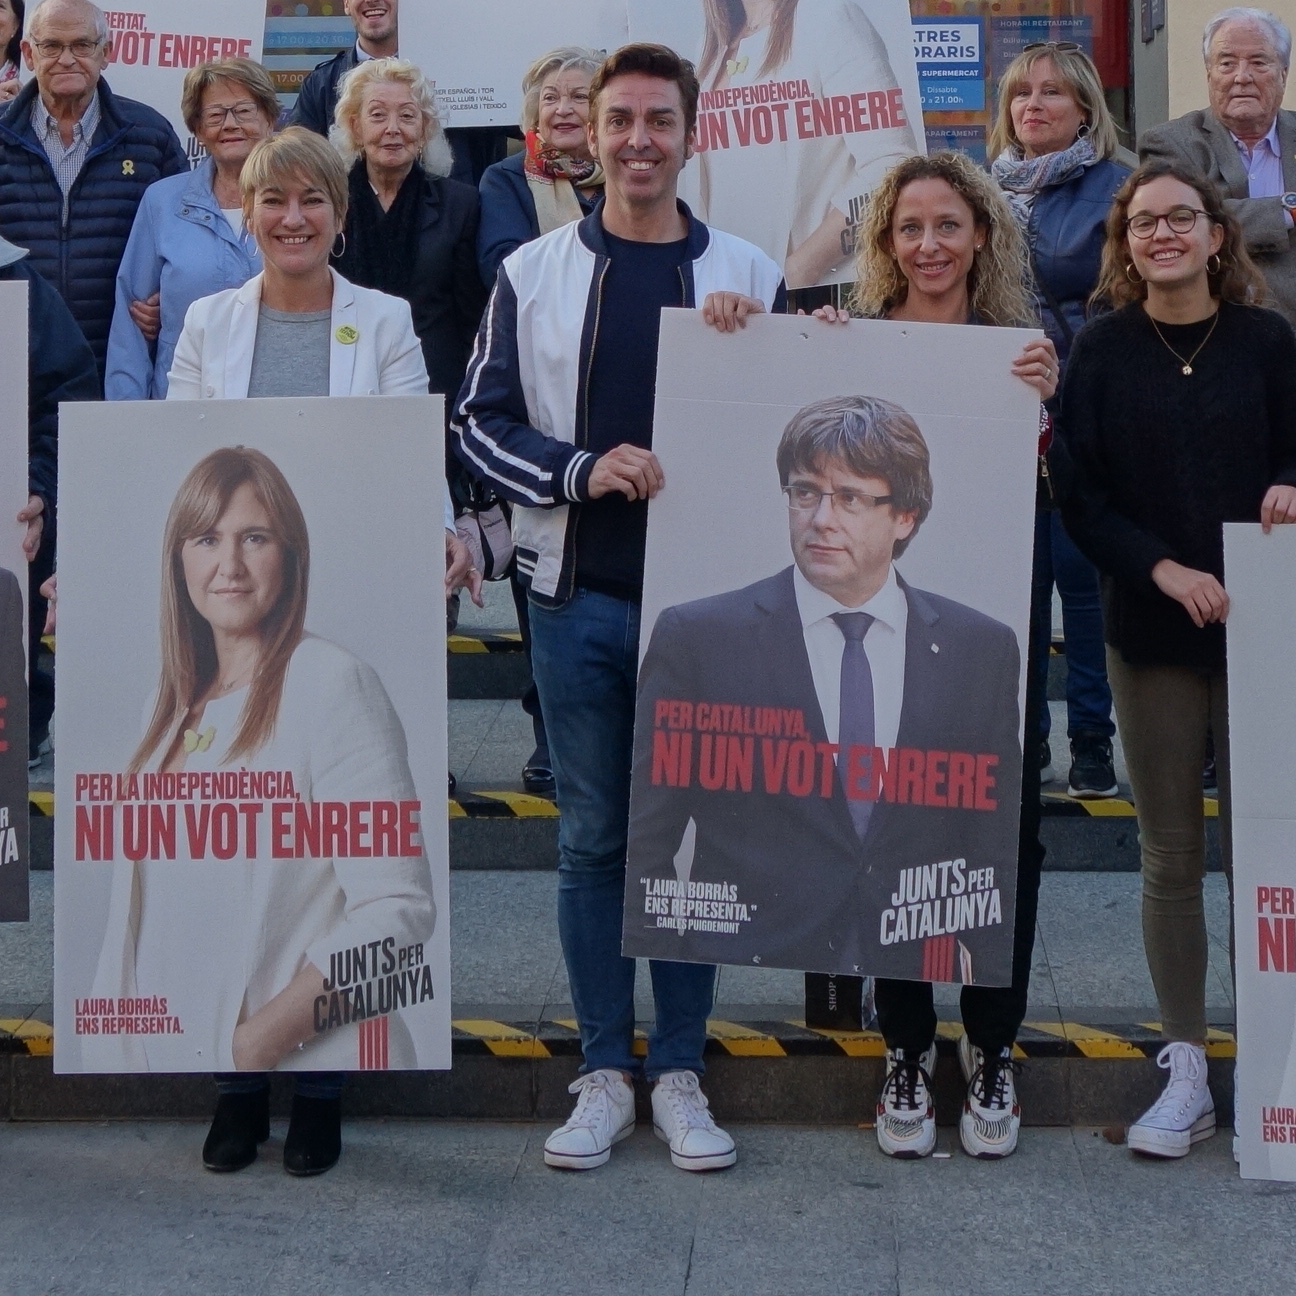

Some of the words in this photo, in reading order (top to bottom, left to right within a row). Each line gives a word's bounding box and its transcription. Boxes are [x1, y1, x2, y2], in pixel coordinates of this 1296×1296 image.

[104, 11, 147, 32] BERTAT,
[1032, 19, 1084, 27] RESTAURANT
[913, 30, 961, 43] TRES
[448, 87, 477, 95] ESPAÑOL
[700, 79, 815, 110] INDEPENDÈNCIA,
[934, 96, 964, 104] 21.00h
[731, 103, 789, 147] VOT
[796, 88, 907, 140] ENRERE
[655, 700, 692, 731] PER
[697, 702, 812, 742] CATALUNYA,
[76, 773, 112, 801] PER
[116, 773, 140, 801] LA
[143, 767, 301, 802] INDEPENDÈNCIA,
[651, 730, 693, 788] NI
[698, 734, 754, 792] UN
[762, 738, 840, 798] VOT
[847, 744, 1000, 811] ENRERE
[76, 805, 113, 861] NI
[122, 804, 176, 861] UN
[184, 803, 263, 860] VOT
[271, 800, 422, 859] ENRERE
[687, 881, 738, 902] BORRÀS
[891, 858, 966, 906] JUNTS
[968, 867, 994, 892] PER
[644, 896, 669, 915] ENS
[1256, 886, 1295, 915] PER
[656, 916, 687, 930] CARLES
[688, 919, 740, 934] PUIGDEMONT
[880, 888, 1002, 946] CATALUNYA
[1258, 918, 1296, 973] NI
[323, 936, 395, 991] JUNTS
[399, 943, 423, 970] PER
[75, 998, 115, 1016] LAURA
[117, 994, 168, 1016] BORRÀS
[313, 965, 434, 1033] CATALUNYA
[828, 981, 837, 1011] SHOP
[75, 1017, 99, 1035] ENS
[102, 1016, 184, 1035] REPRESENTA.
[1263, 1125, 1287, 1143] ENS
